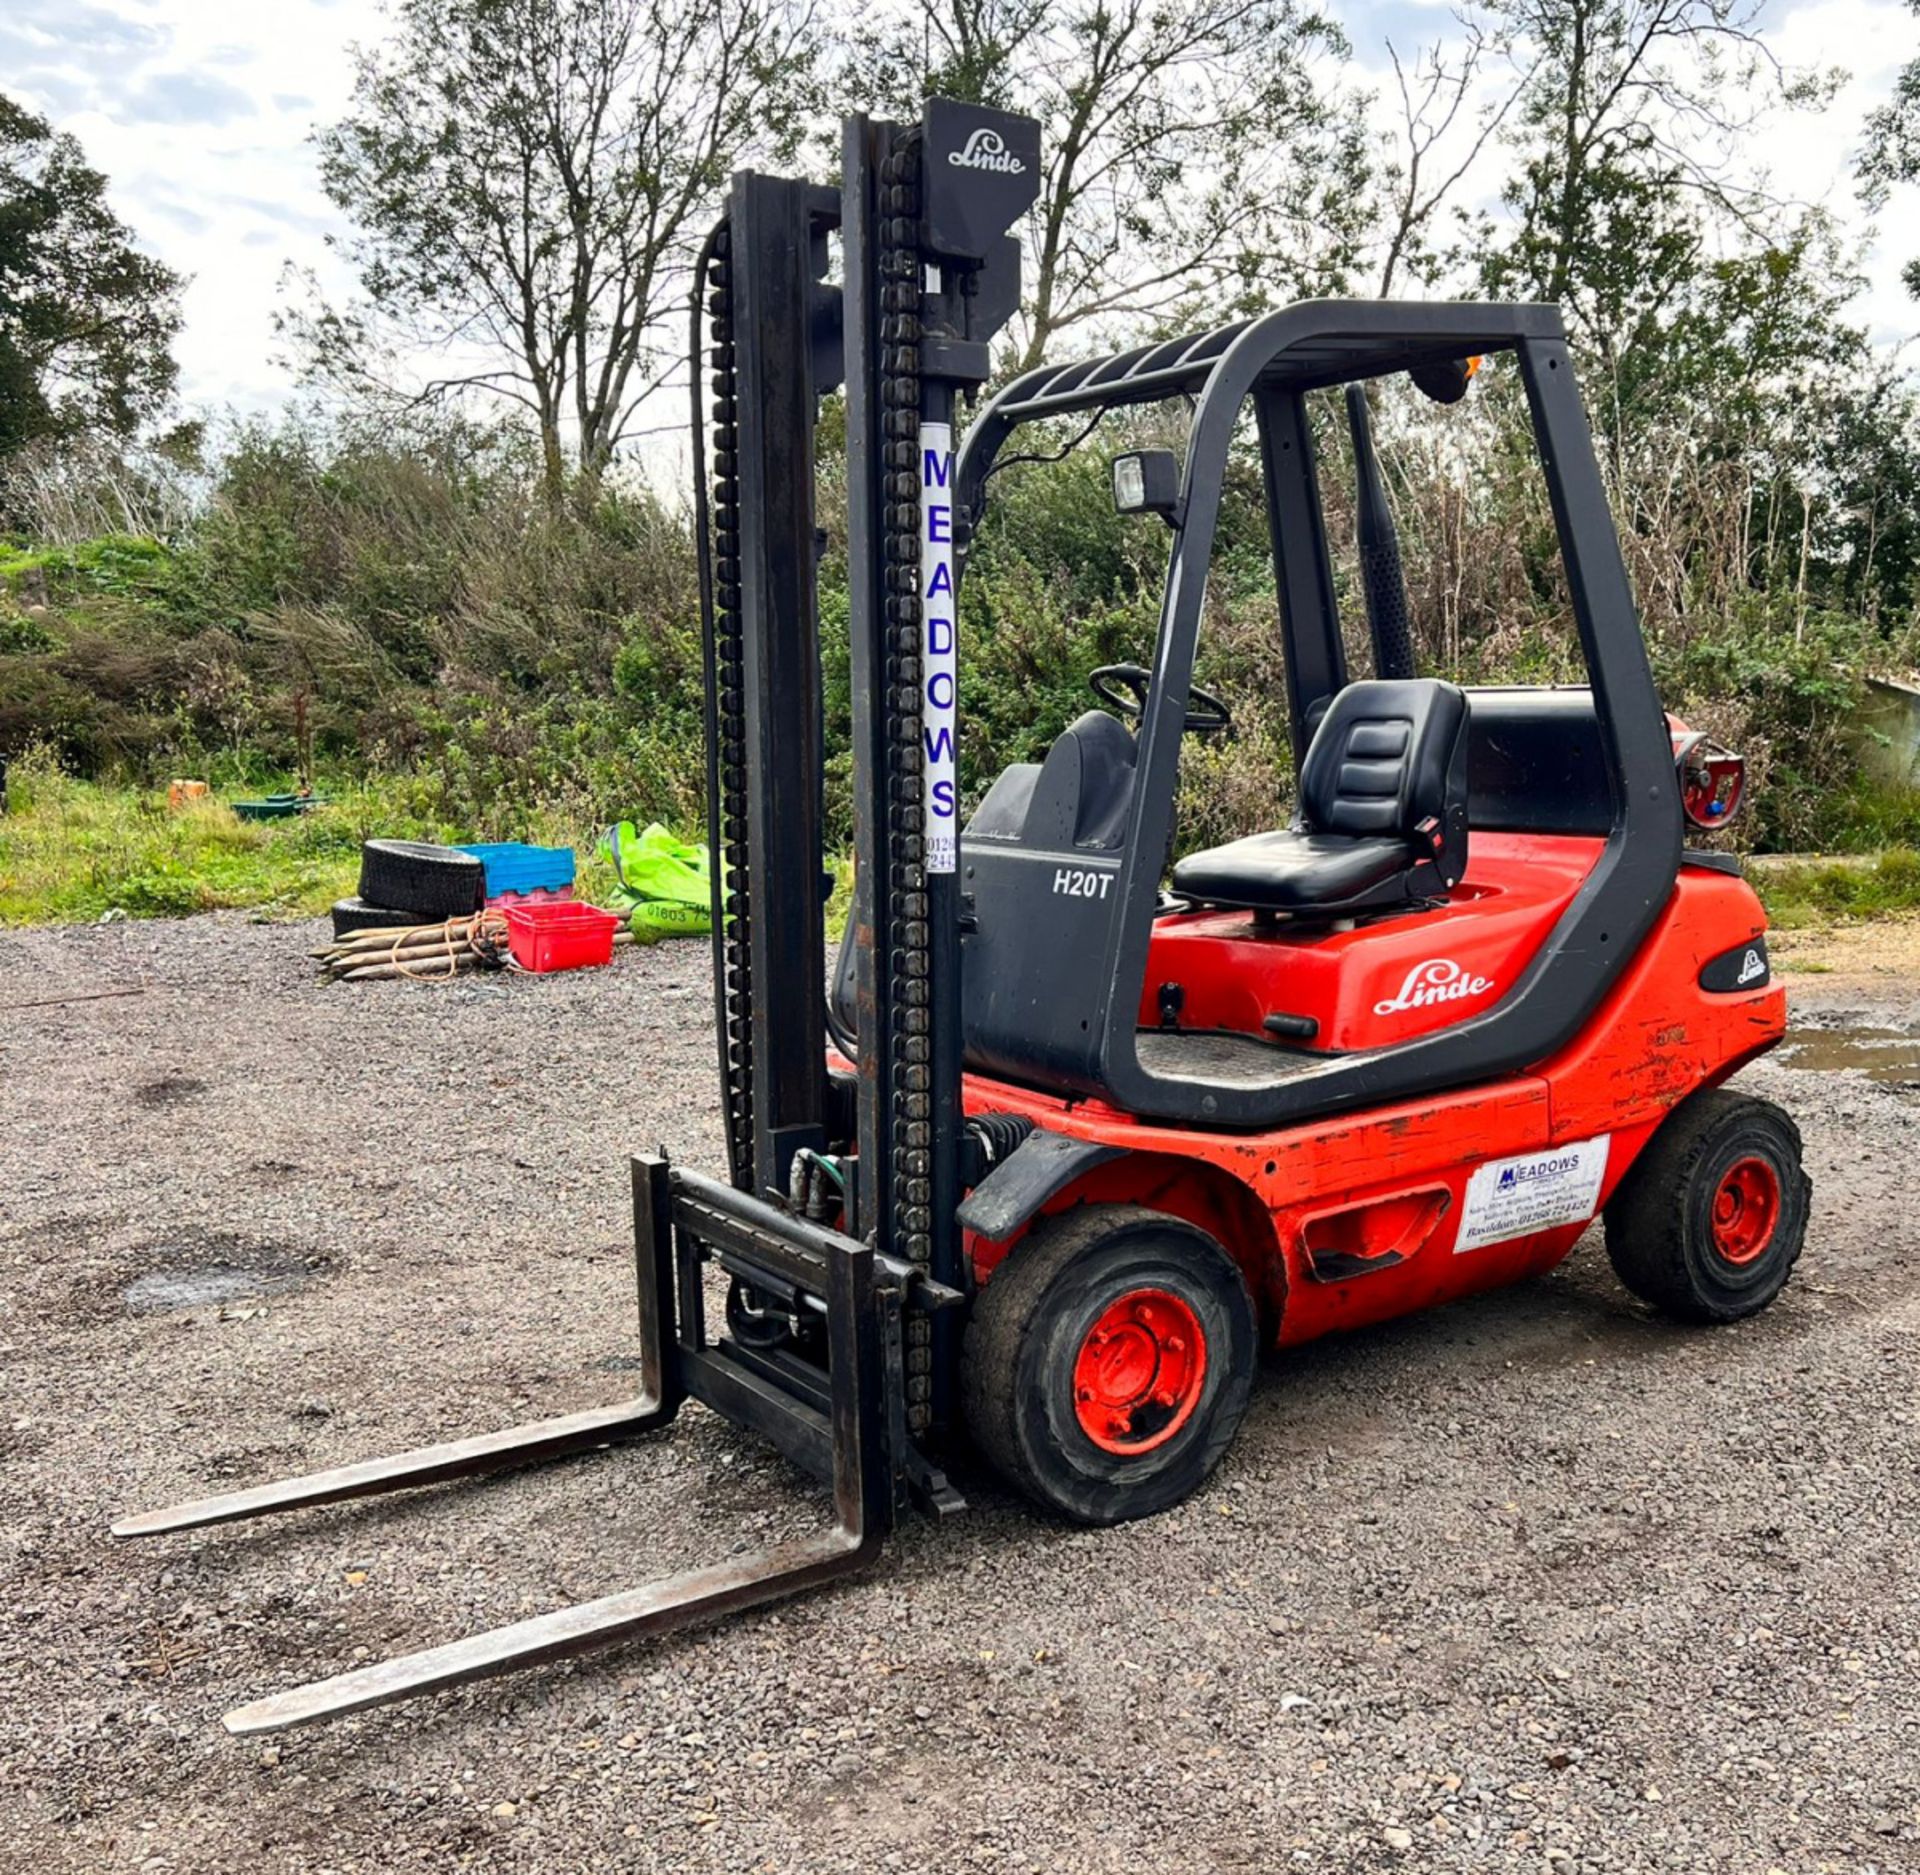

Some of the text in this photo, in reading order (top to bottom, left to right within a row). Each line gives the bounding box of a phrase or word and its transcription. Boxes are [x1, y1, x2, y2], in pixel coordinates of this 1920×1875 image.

[948, 128, 1026, 174] Linde
[924, 449, 955, 818] MEADOWS
[1053, 869, 1114, 899] H20T
[1373, 958, 1495, 1015] Linde
[1500, 1154, 1580, 1184] MEADOWS
